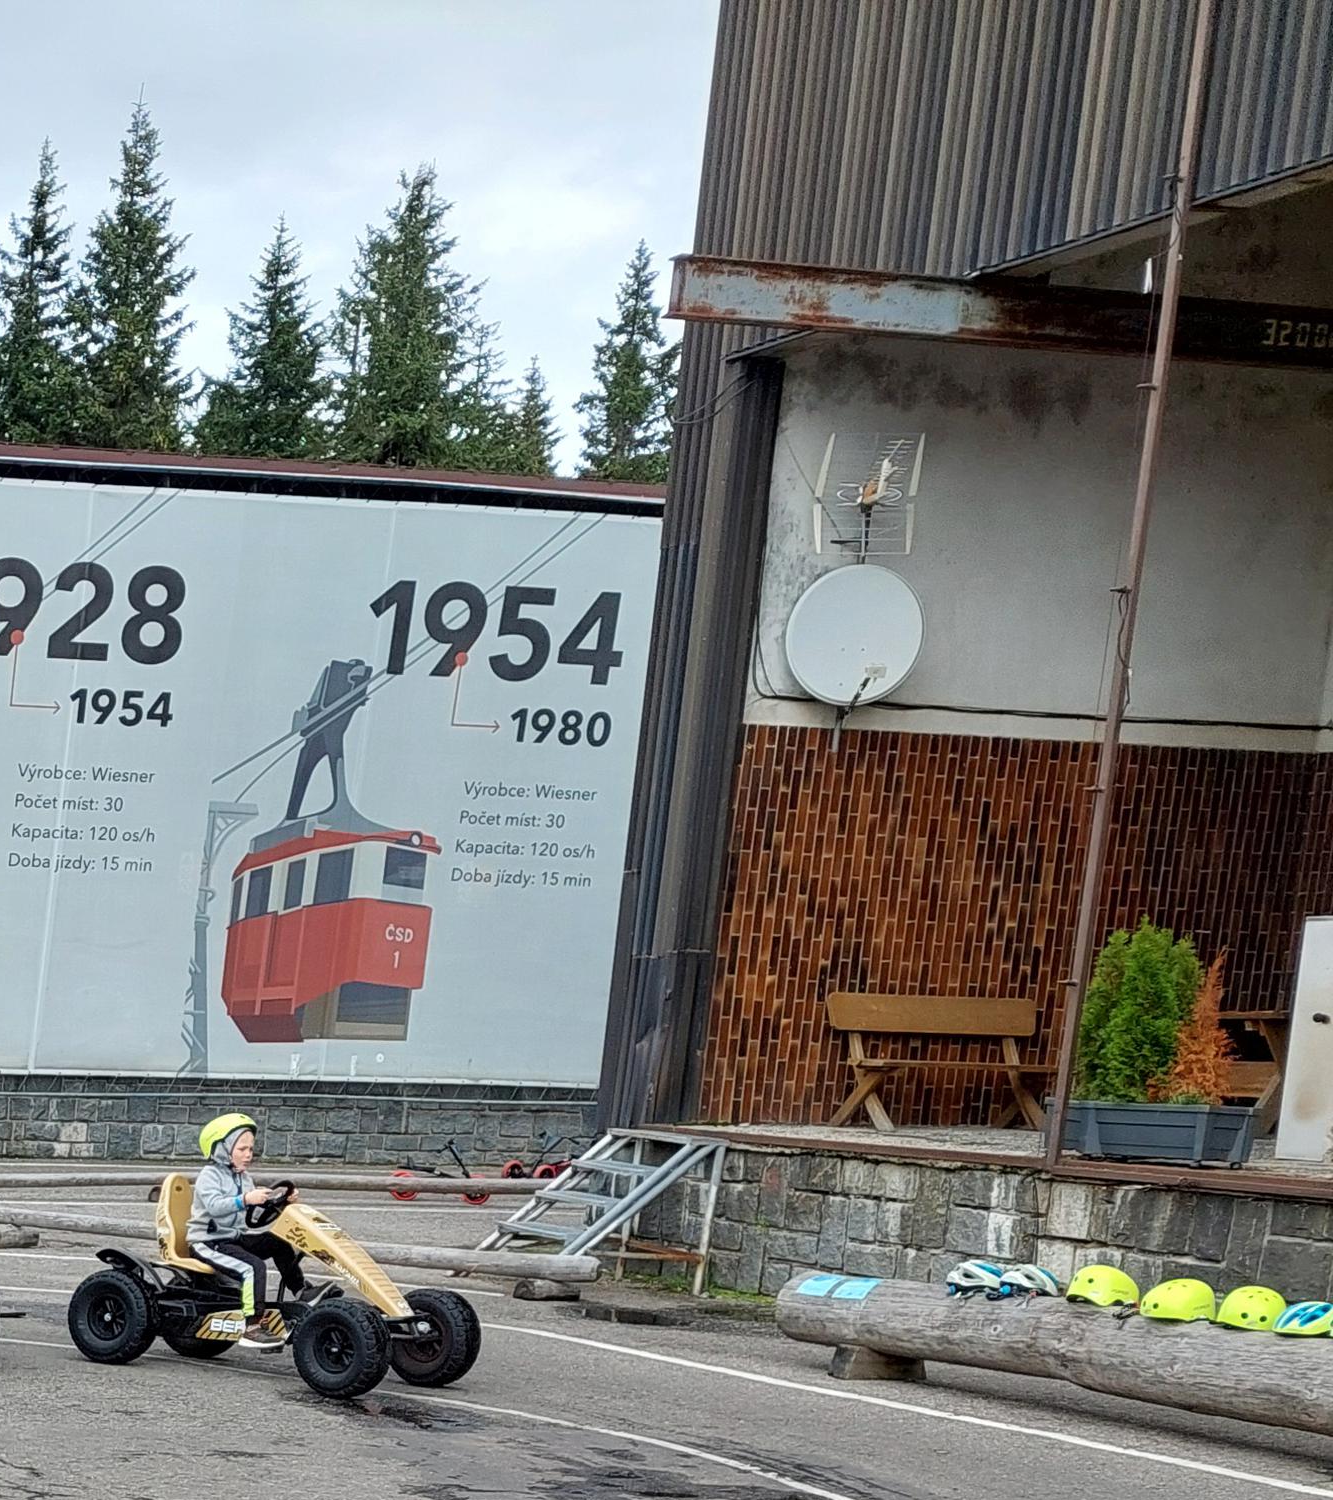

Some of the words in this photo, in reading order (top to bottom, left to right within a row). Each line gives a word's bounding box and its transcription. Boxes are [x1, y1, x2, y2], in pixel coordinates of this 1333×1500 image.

[370, 579, 624, 686] 1954
[70, 688, 173, 728] 1954
[511, 708, 612, 747] 1980
[18, 763, 87, 783] Výrobce:
[92, 767, 156, 783] Wiesner
[464, 781, 530, 800] Výrobce:
[535, 784, 598, 801] Wiesner
[15, 793, 58, 809] Počet
[62, 796, 99, 811] míst:
[104, 797, 124, 812] 30
[459, 810, 501, 825] Počet
[505, 813, 541, 827] míst:
[546, 814, 565, 829] 30
[12, 823, 84, 842] Kapacita:
[89, 826, 118, 841] 120
[122, 828, 156, 842] os/h
[455, 839, 525, 857] Kapacita:
[531, 842, 558, 857] 120
[563, 844, 596, 859] os/h
[8, 853, 50, 868] Doba
[54, 855, 96, 873] jízdy:
[102, 856, 119, 871] 15
[125, 858, 153, 872] min
[451, 868, 492, 883] Doba
[494, 870, 535, 888] jízdy:
[541, 872, 558, 886] 15
[564, 873, 591, 887] min
[385, 923, 413, 943] ČSD
[393, 950, 400, 969] 1
[210, 1318, 246, 1333] BER
